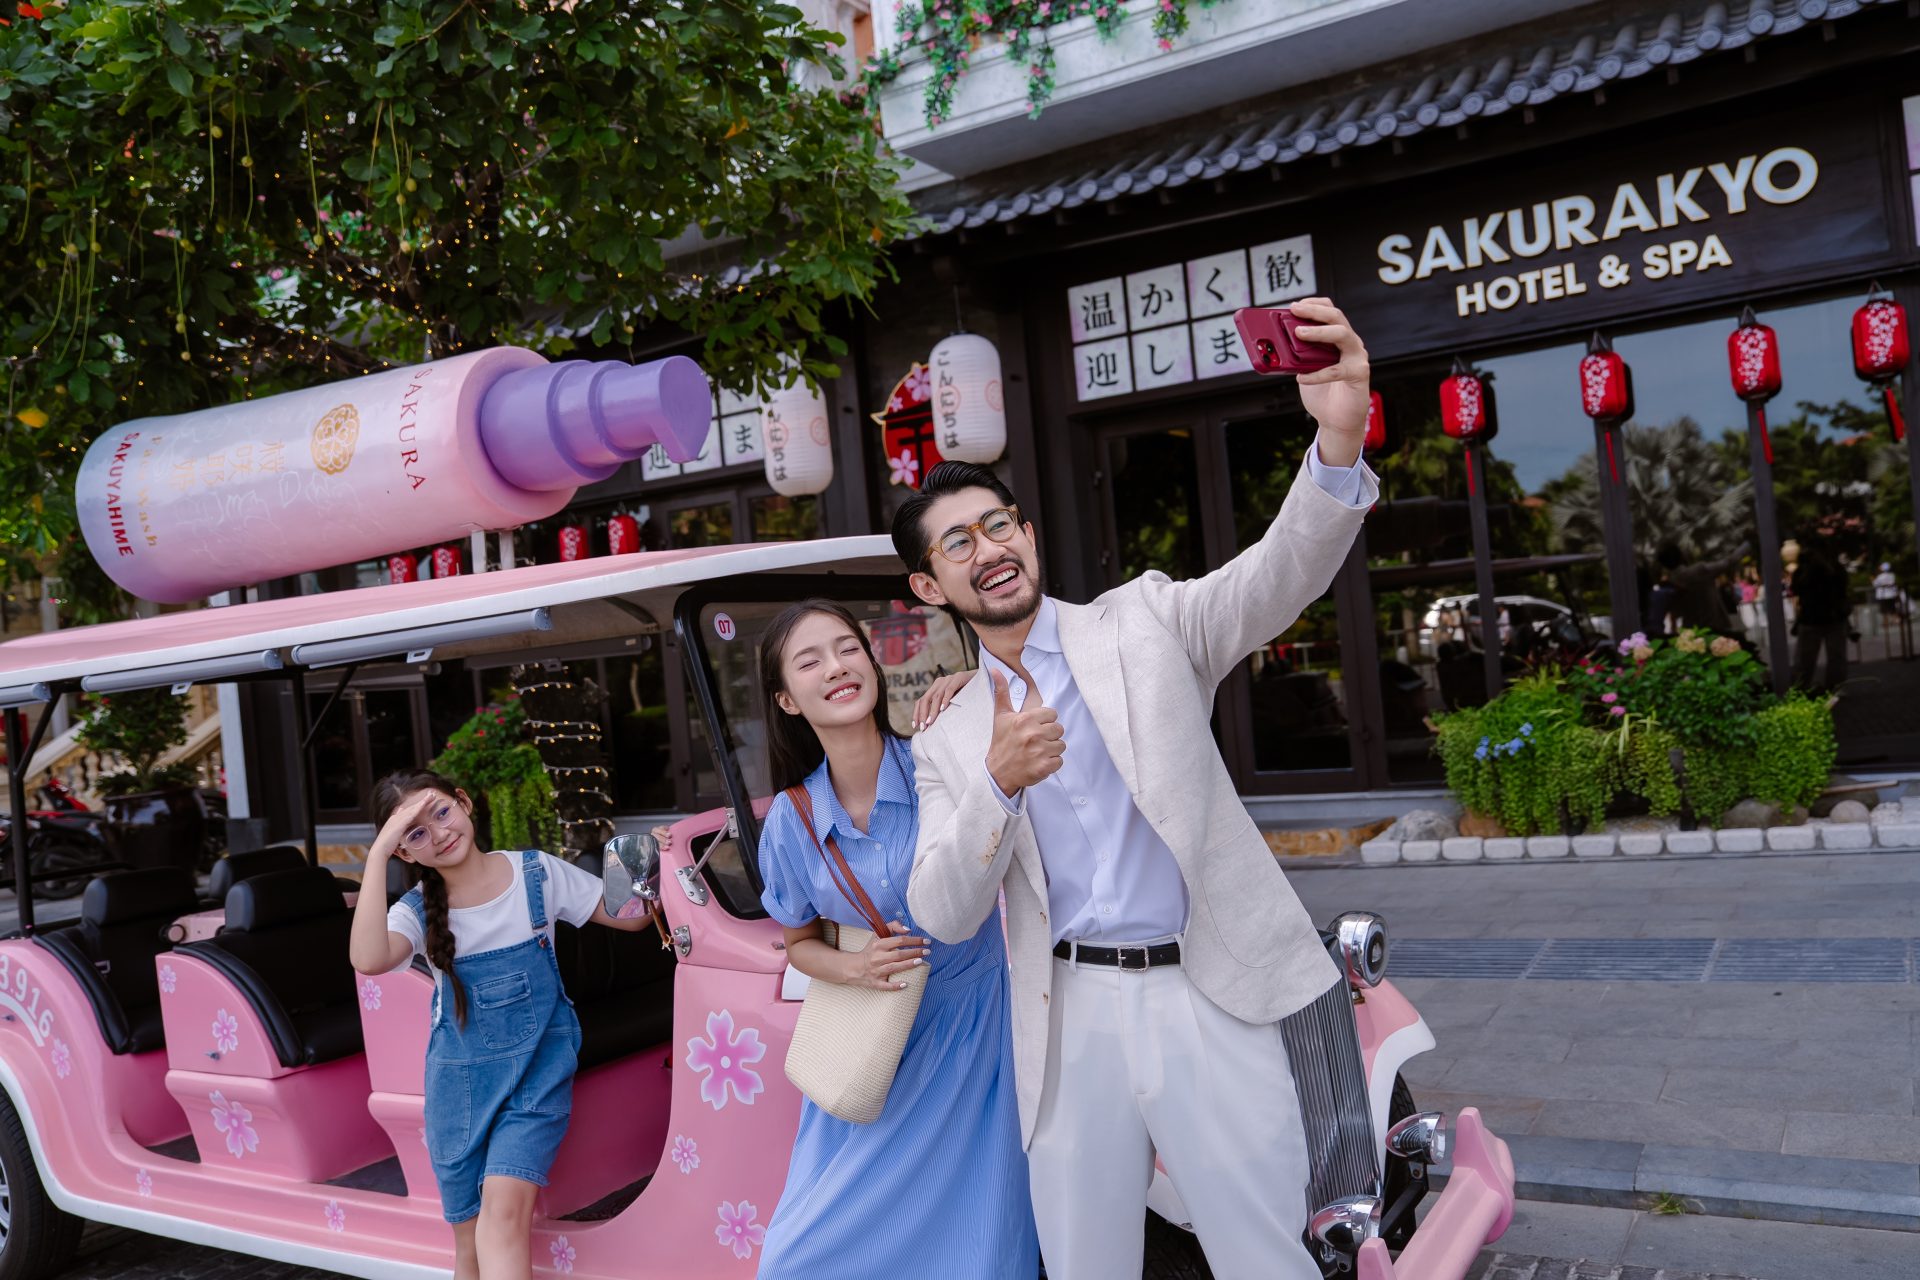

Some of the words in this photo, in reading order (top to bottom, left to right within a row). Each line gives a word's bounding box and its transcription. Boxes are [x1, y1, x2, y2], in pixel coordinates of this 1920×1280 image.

[1376, 146, 1820, 286] SAKURAKYO
[1081, 250, 1304, 331] 温かく歓
[1456, 262, 1588, 318] HOTEL
[1597, 253, 1631, 288] &
[1642, 234, 1733, 280] SPA
[399, 368, 433, 491] SAKURA
[937, 350, 961, 449] こんにちは
[107, 432, 140, 557] SAKUYAHIME
[718, 619, 731, 635] 07
